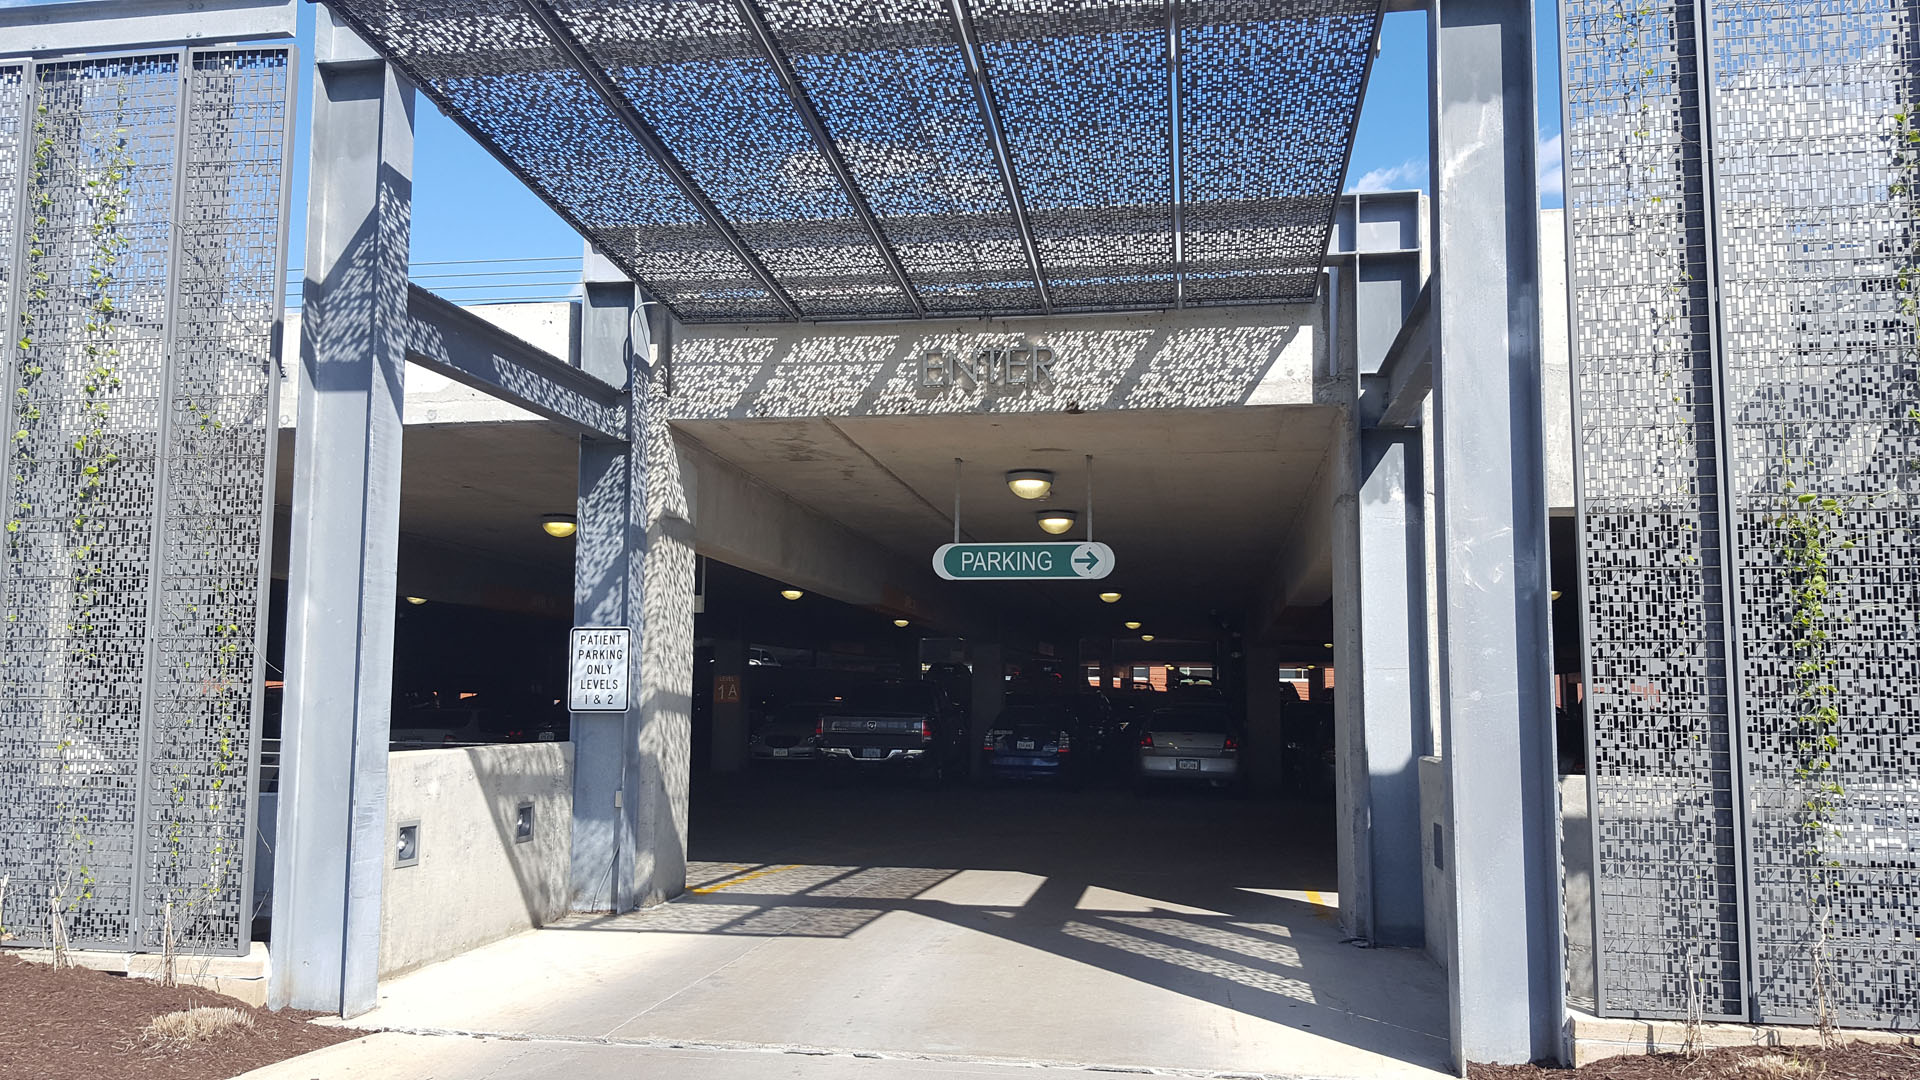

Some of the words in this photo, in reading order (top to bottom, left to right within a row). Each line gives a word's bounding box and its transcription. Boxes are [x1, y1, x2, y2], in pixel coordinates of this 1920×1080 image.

[922, 345, 1056, 386] ENTER
[961, 551, 1053, 572] PARKING
[580, 634, 621, 645] PATIENT
[578, 649, 623, 660] PARKING
[586, 664, 613, 675] ONLY
[580, 679, 619, 690] LEVELS
[593, 694, 601, 705] &
[607, 694, 614, 705] 2
